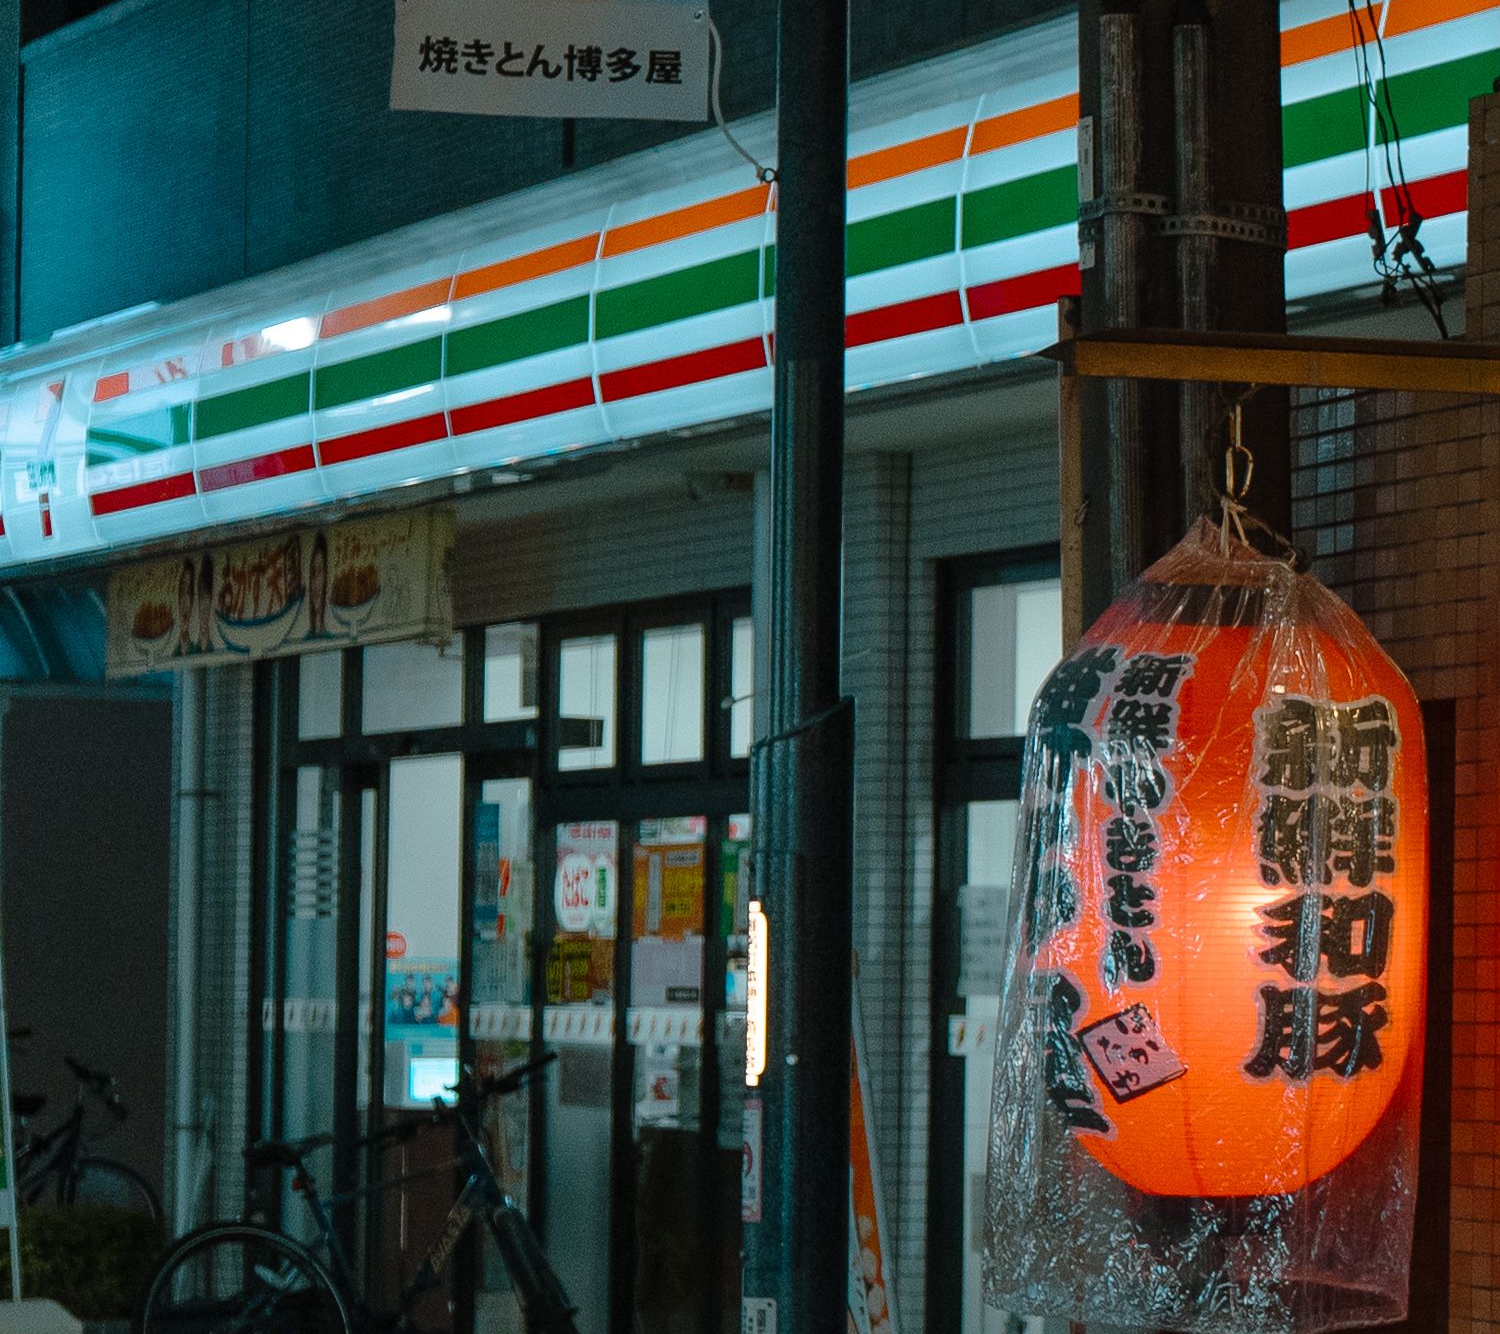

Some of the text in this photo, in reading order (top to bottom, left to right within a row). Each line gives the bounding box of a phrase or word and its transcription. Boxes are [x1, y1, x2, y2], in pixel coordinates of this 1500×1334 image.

[419, 34, 683, 85] 焼きとん博多屋
[1244, 696, 1399, 1079] 新鮮和豚
